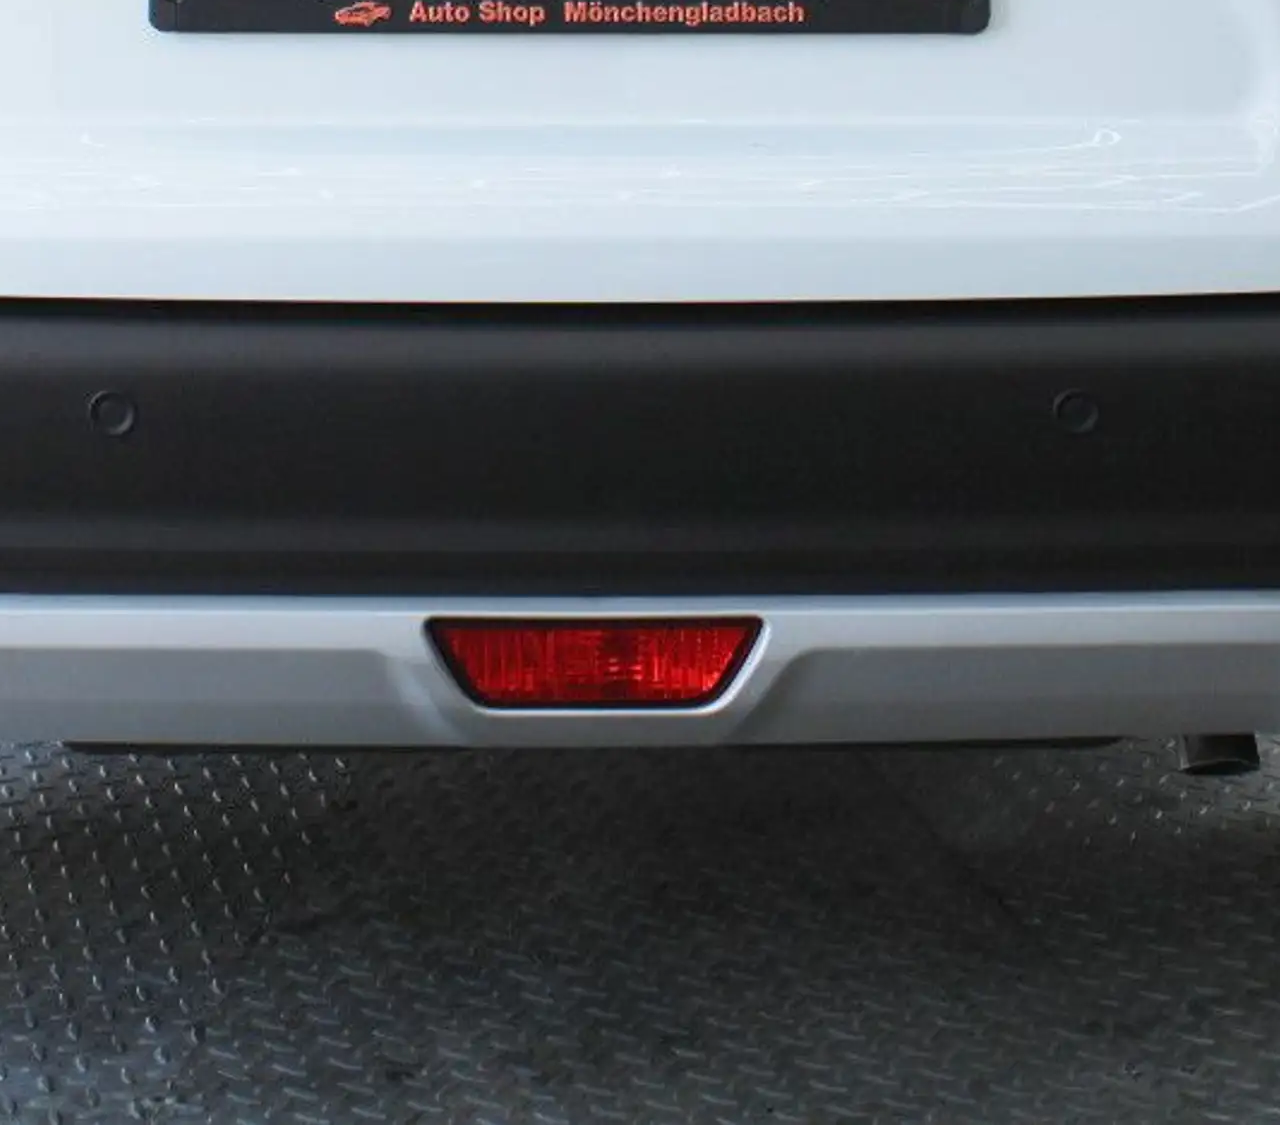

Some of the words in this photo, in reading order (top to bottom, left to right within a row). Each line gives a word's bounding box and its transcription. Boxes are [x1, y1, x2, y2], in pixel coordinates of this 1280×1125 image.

[409, 1, 470, 24] Auto
[479, 0, 546, 25] Shop
[564, 0, 805, 26] Mönchengladbach
